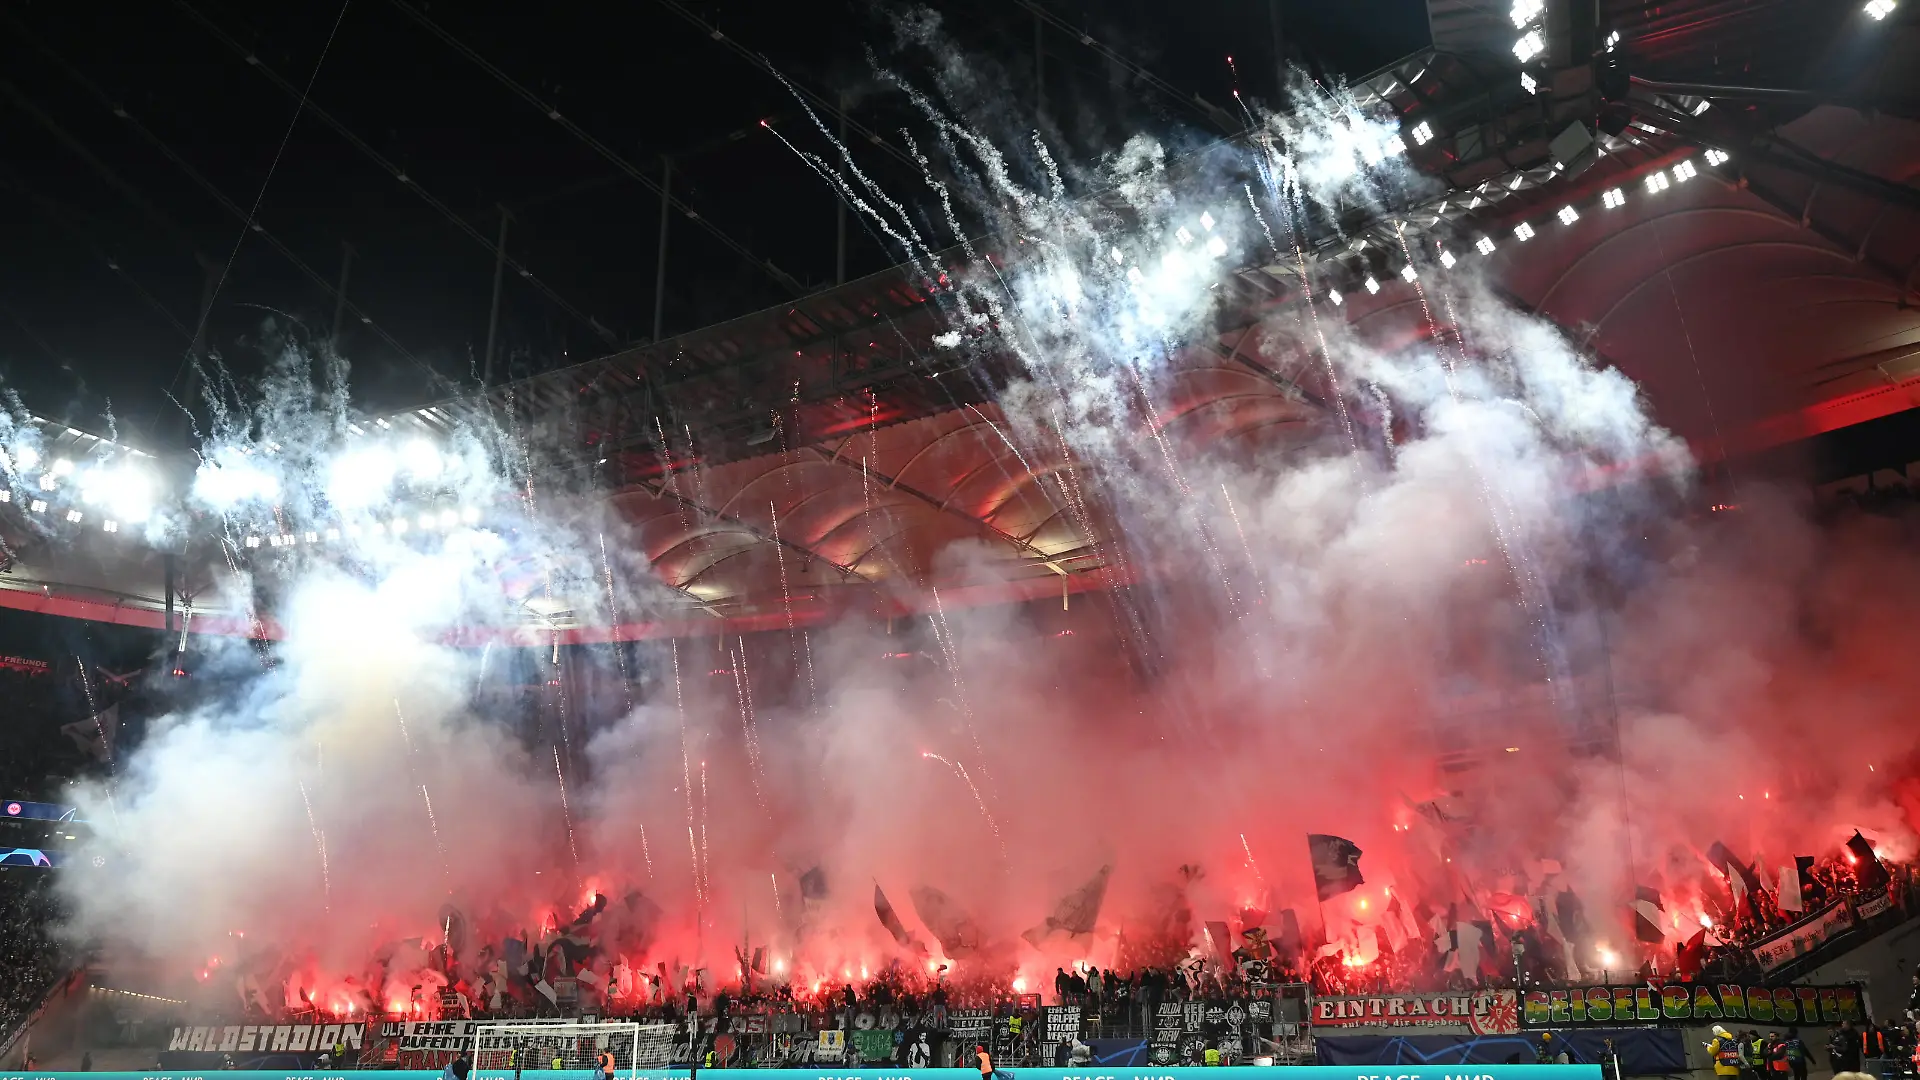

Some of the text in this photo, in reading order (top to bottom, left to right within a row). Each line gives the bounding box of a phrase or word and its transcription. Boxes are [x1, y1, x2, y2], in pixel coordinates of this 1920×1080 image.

[4, 656, 48, 668] FREUNDE
[1158, 1002, 1183, 1014] FULDA
[1319, 996, 1492, 1019] EINTRACHT
[413, 1022, 456, 1036] EHRE
[954, 1020, 985, 1028] NEVER
[1342, 1018, 1461, 1029] auf ewig dir ergeben
[168, 1023, 366, 1052] WALDSTADION
[1157, 1030, 1180, 1042] CREW
